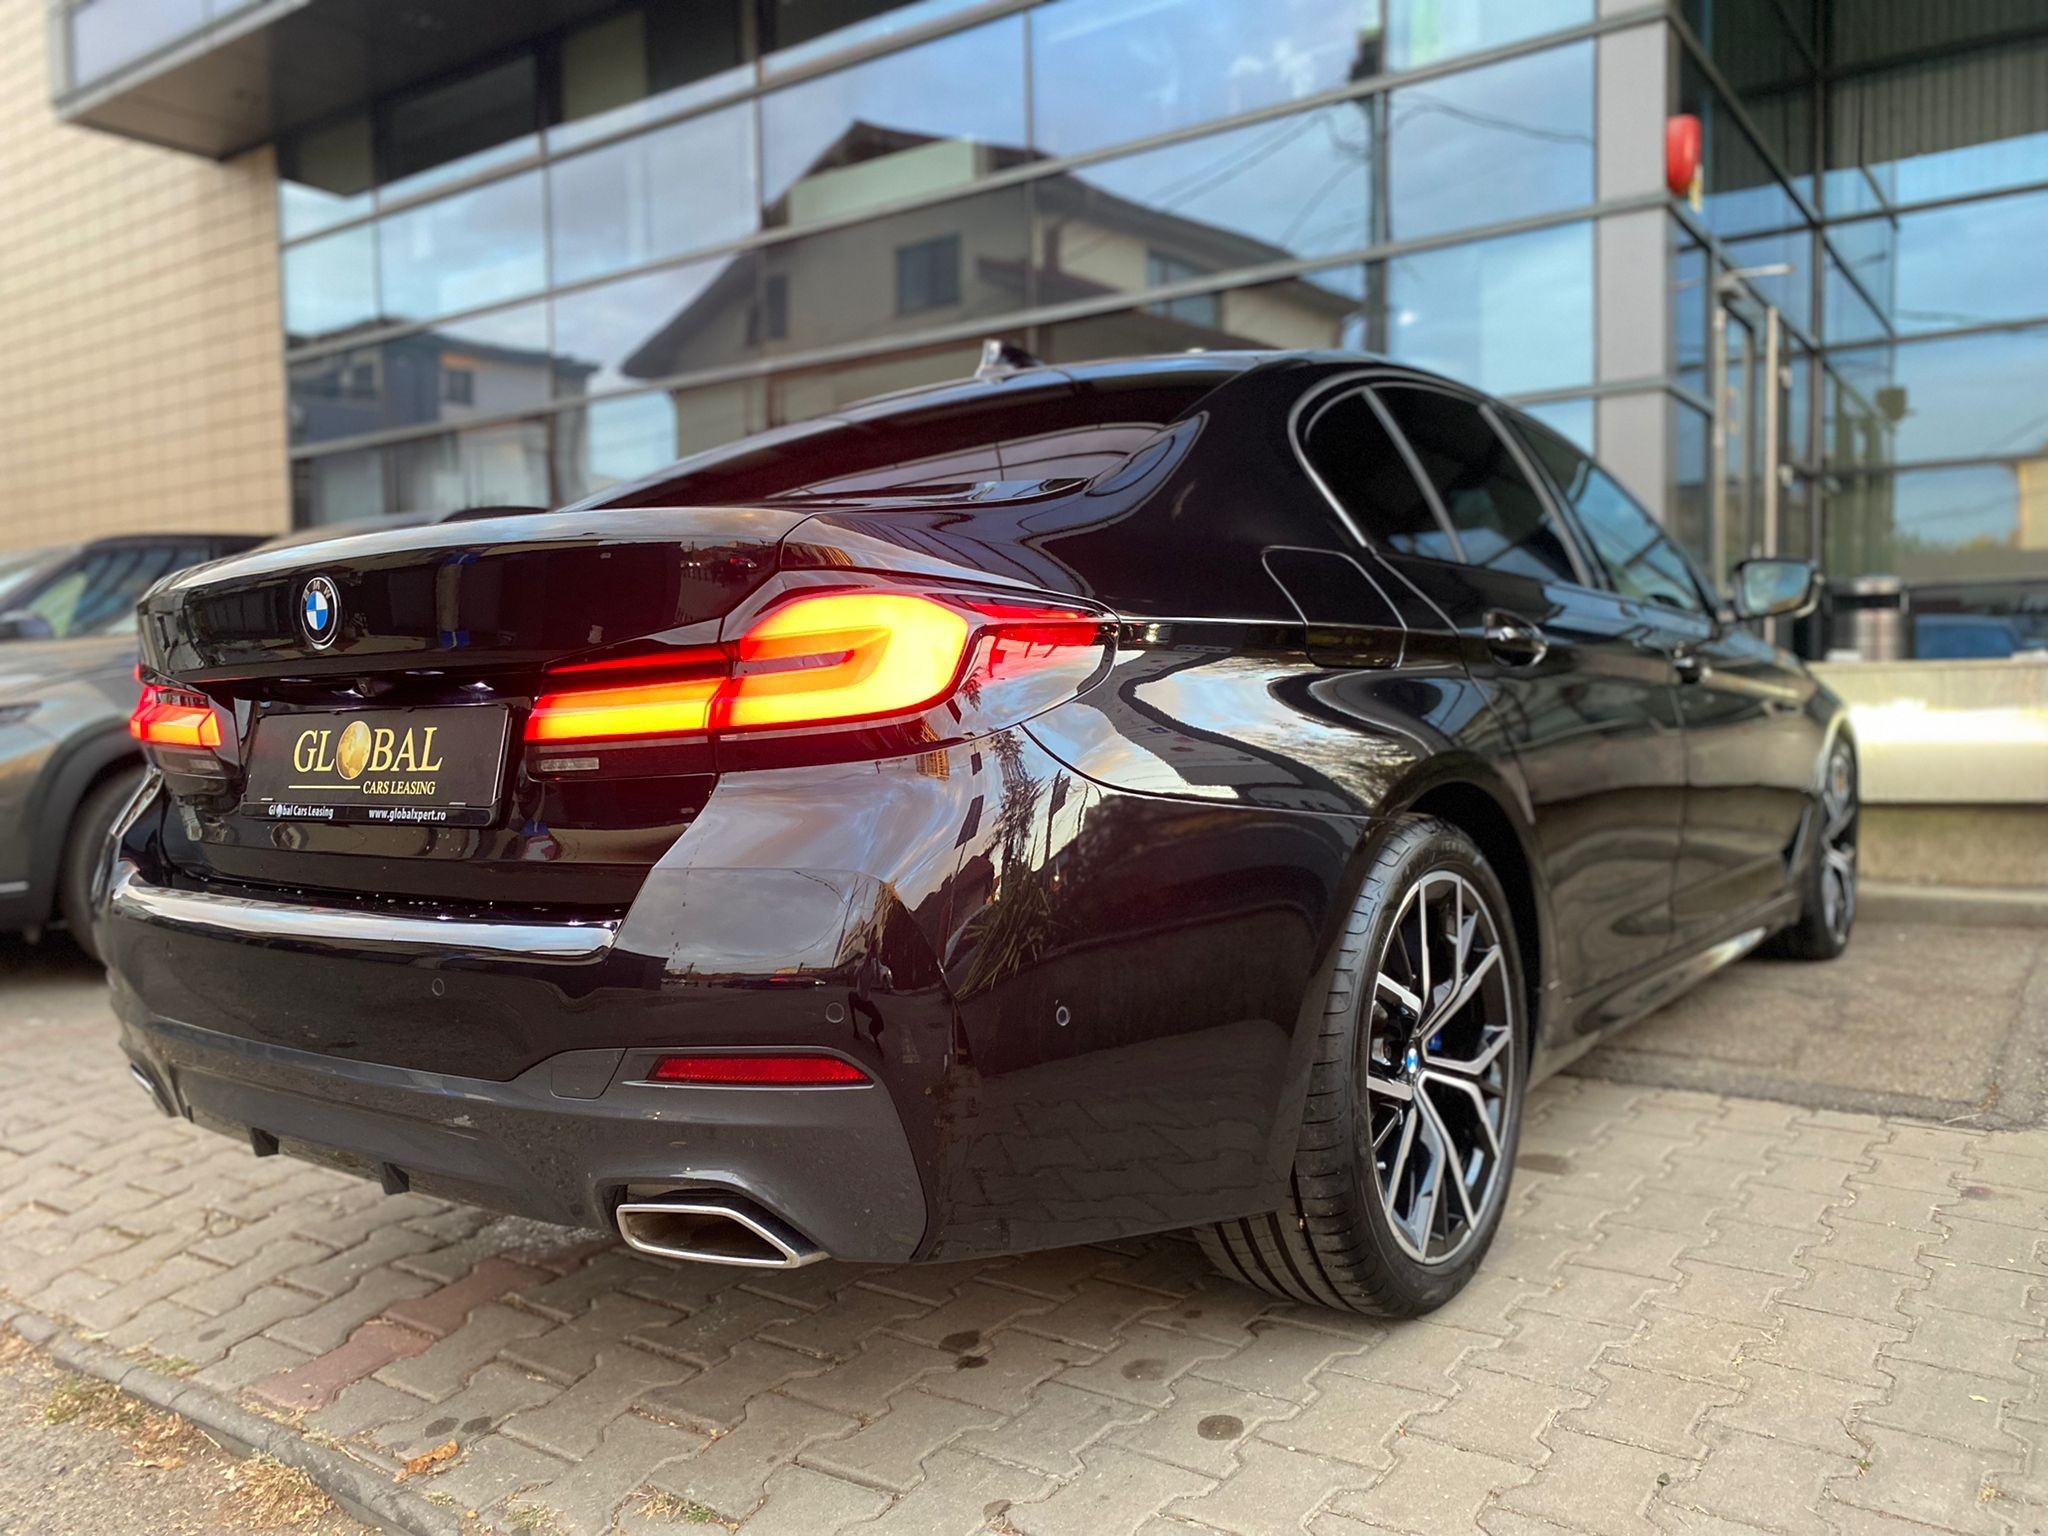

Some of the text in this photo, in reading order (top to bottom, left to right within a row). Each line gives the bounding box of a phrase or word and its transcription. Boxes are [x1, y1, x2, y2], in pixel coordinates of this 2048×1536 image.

[303, 580, 332, 601] BMW
[293, 720, 443, 780] GLOBAL
[363, 780, 436, 795] CARS LEASING
[293, 805, 307, 816] Cars
[308, 805, 334, 820] Leasing
[368, 807, 447, 823] www.globalxpert.ro
